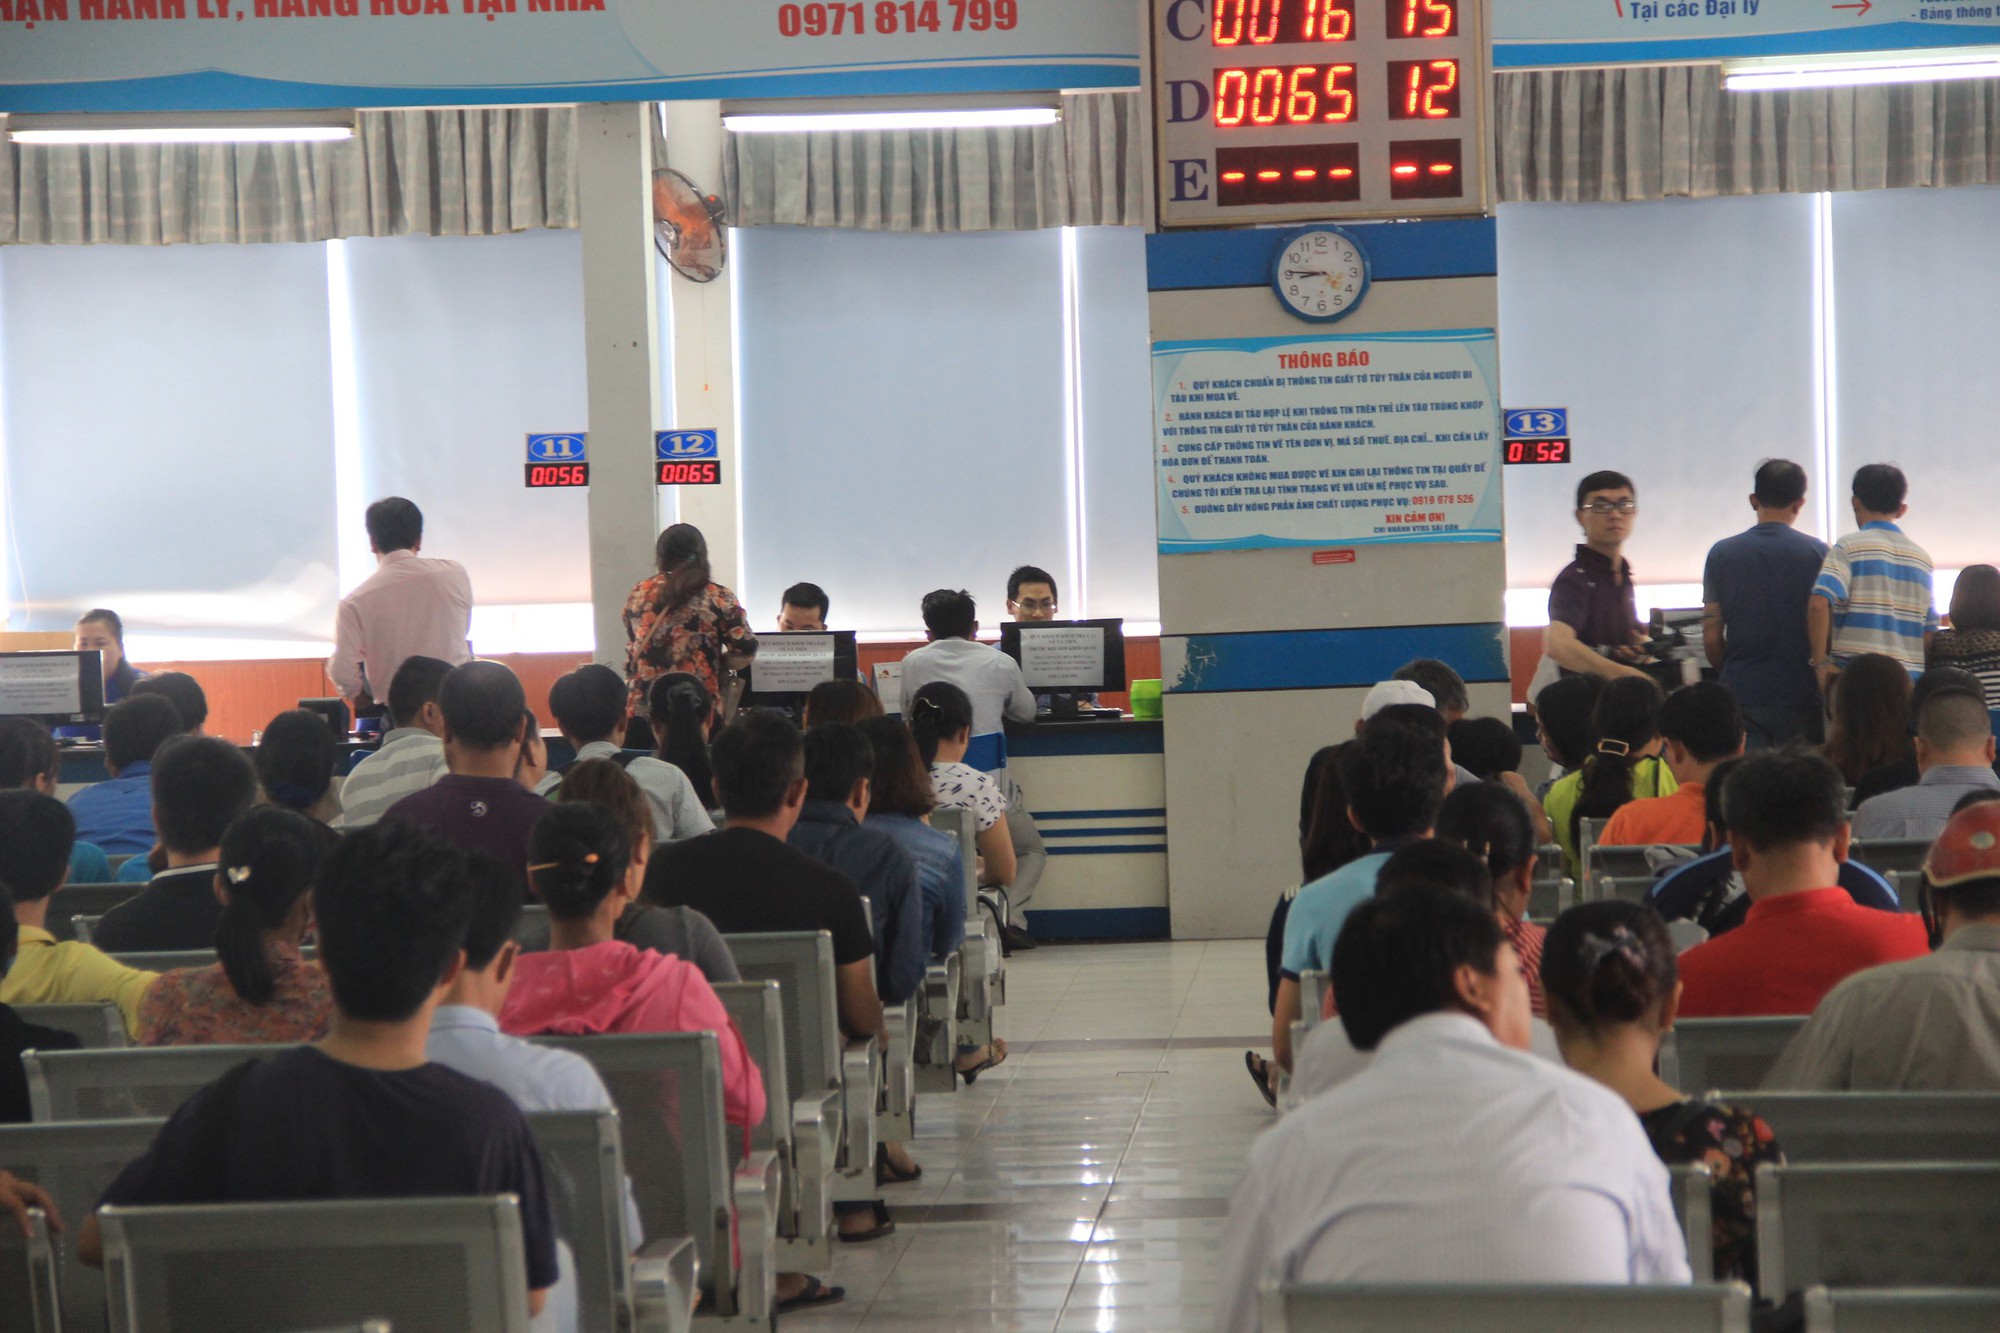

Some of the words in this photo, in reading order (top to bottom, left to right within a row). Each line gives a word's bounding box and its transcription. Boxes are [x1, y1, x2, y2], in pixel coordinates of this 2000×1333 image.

[778, 3, 864, 36] 0971
[874, 1, 940, 34] 814
[948, 0, 1018, 31] 799
[1166, 0, 1205, 41] C
[1631, 2, 1658, 22] Tại
[1957, 5, 1992, 18] thông
[1212, 0, 1350, 45] 0016
[1402, 0, 1452, 36] 15
[1166, 80, 1210, 122] D
[1215, 65, 1353, 125] 0065
[1406, 60, 1456, 117] 12
[1169, 158, 1208, 201] E
[1278, 353, 1332, 369] THÔNG
[1337, 351, 1369, 367] BÁO
[1288, 376, 1316, 386] THÔNG
[1188, 394, 1204, 402] KHI
[1206, 393, 1225, 401] MUA
[1292, 408, 1308, 416] KHI
[1310, 406, 1338, 415] THÔNG
[1179, 425, 1207, 435] THÔNG
[1209, 426, 1223, 434] TIN
[1518, 413, 1555, 432] 13
[542, 439, 573, 457] 11
[670, 435, 704, 454] 12
[1177, 444, 1202, 452] CUNG
[1224, 440, 1254, 450] THÔNG
[1256, 441, 1270, 449] TIN
[1435, 434, 1451, 442] KHI
[1214, 456, 1242, 464] THANH
[531, 466, 584, 485] 0056
[661, 464, 715, 483] 0065
[1269, 471, 1290, 480] MUA
[1332, 469, 1347, 477] XIN
[1349, 468, 1365, 477] GHI
[1383, 465, 1413, 476] THÔNG
[1416, 466, 1430, 474] TIN
[1244, 487, 1260, 495] TRA
[1412, 496, 1435, 505] 0919
[1456, 495, 1474, 504] 526
[1386, 514, 1402, 523] XIN
